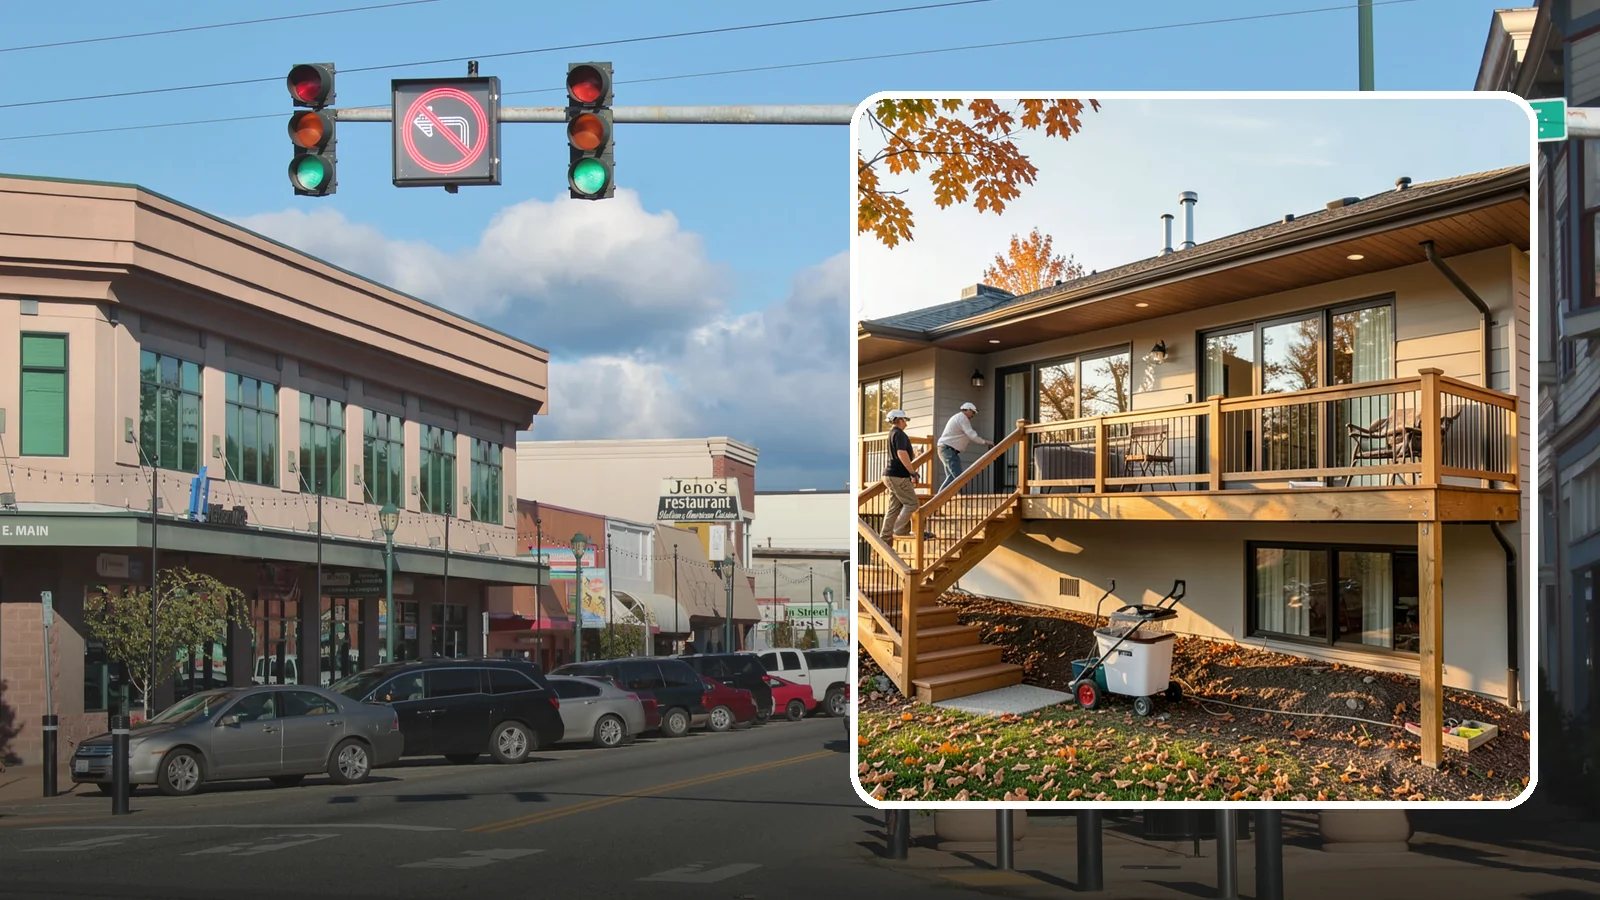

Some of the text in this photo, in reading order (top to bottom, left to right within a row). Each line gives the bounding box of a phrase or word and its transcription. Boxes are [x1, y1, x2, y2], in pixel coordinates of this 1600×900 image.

[670, 480, 727, 494] Jeno's
[665, 496, 731, 509] restaurant
[659, 510, 681, 519] Italian
[686, 510, 714, 519] American
[715, 509, 737, 519] Cuisine
[2, 525, 49, 536] E. MAIN
[798, 608, 828, 616] Street
